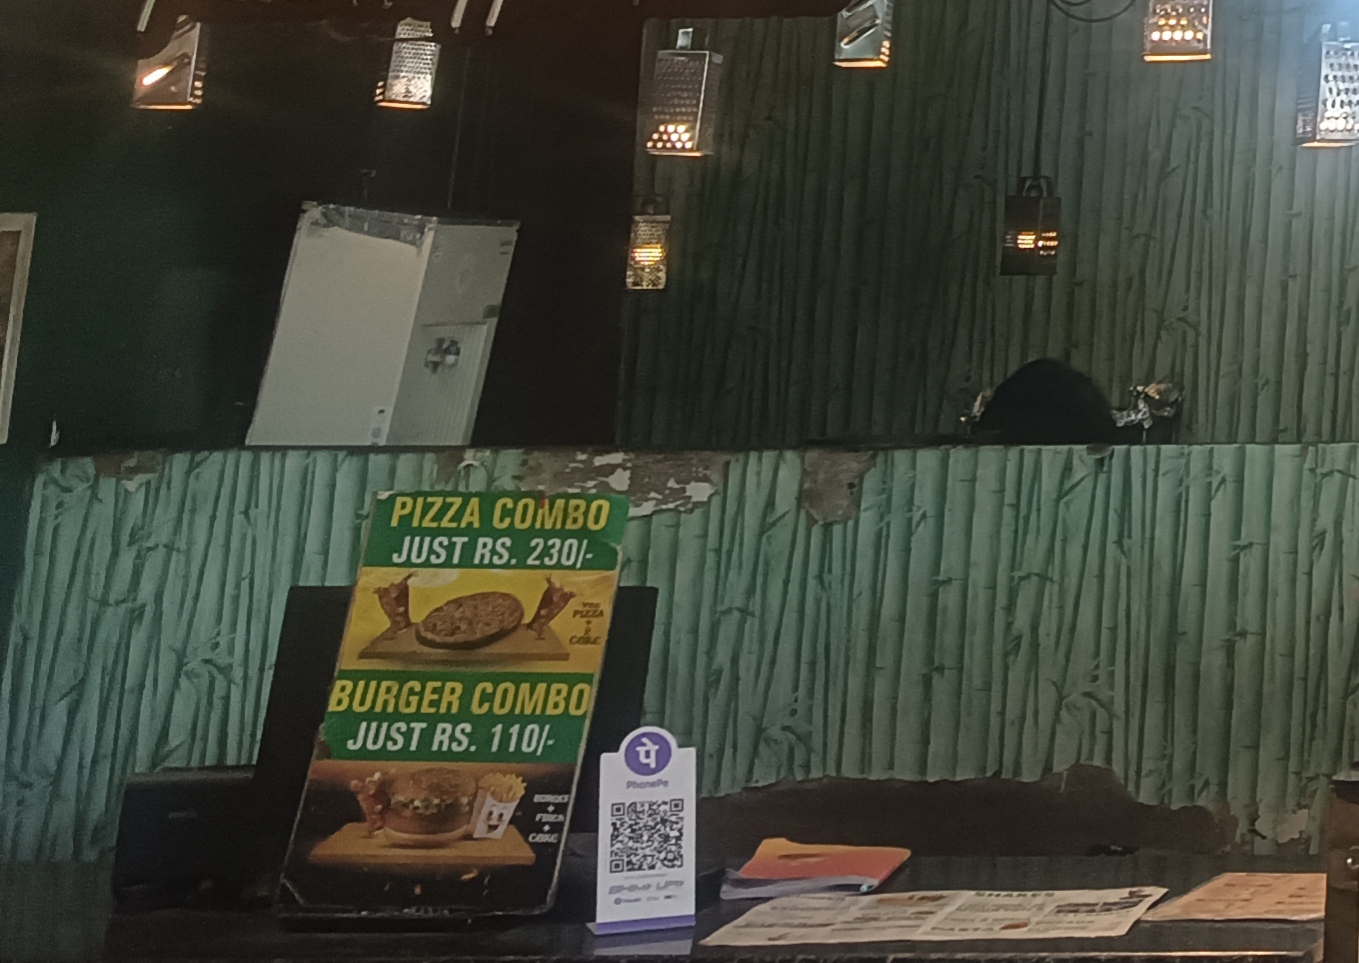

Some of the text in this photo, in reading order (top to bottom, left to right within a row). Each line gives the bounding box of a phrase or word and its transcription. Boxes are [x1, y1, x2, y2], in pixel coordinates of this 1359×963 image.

[390, 496, 610, 531] PIZZA COMBO
[392, 536, 594, 568] JUST RS. 230/-
[328, 680, 591, 716] BURGER COMBO
[346, 722, 555, 755] JUST RS. 110/-
